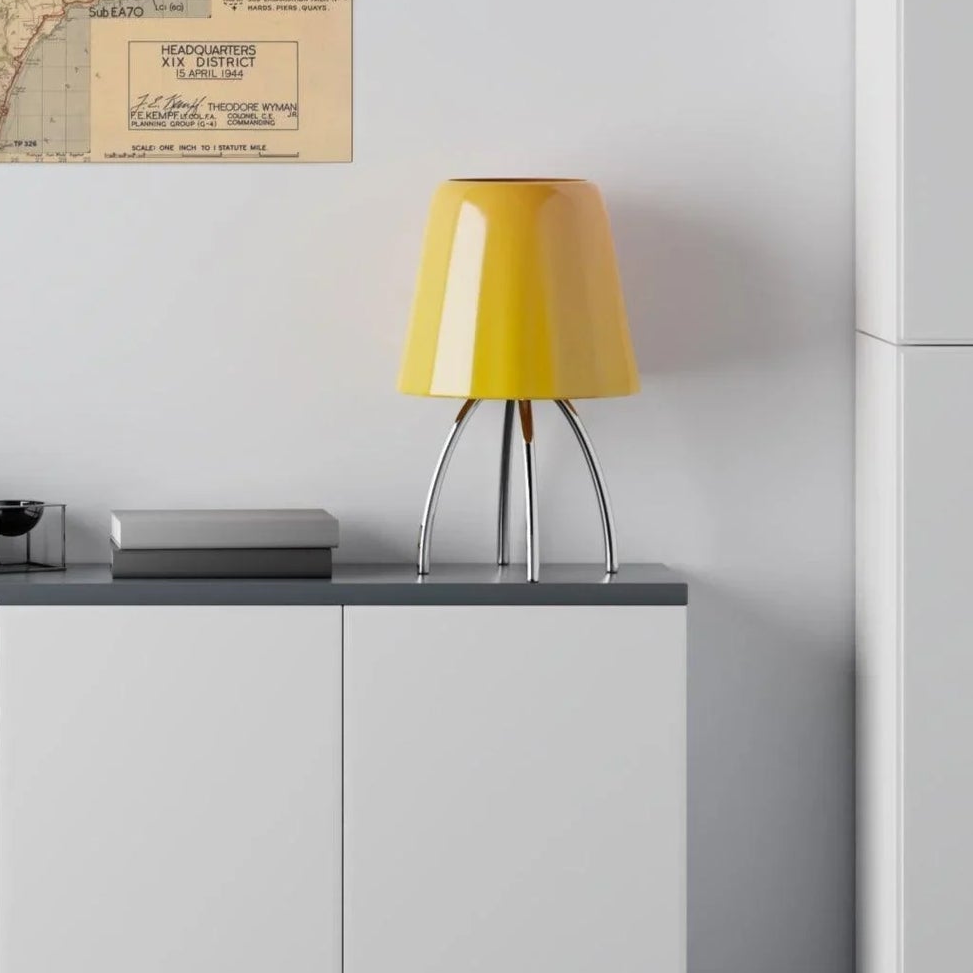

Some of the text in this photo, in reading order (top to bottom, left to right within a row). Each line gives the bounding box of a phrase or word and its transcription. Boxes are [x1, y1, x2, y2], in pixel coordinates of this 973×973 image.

[89, 7, 109, 18] Sub
[161, 45, 257, 56] HEADQUARTERS
[162, 57, 256, 67] XIX DISTRICT
[177, 69, 244, 78] 15 APRIL 1944
[208, 102, 297, 111] THEODORE WYMAN
